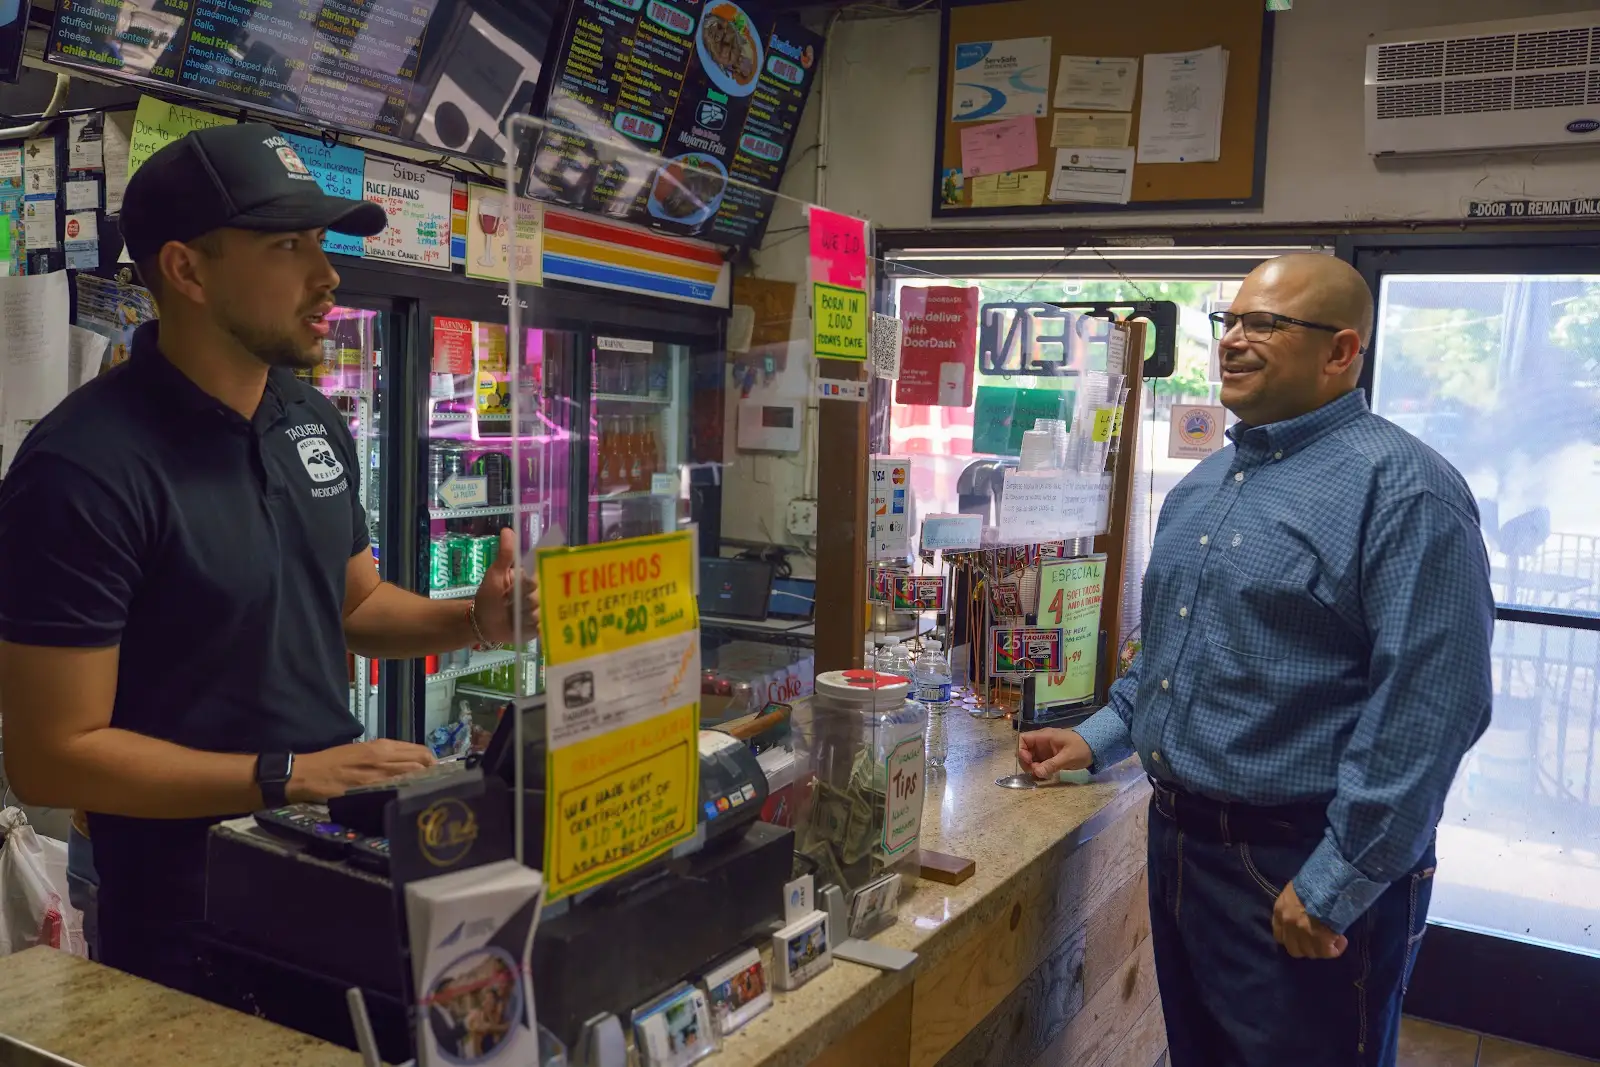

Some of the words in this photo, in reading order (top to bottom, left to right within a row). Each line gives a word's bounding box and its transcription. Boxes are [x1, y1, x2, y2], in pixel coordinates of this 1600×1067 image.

[63, 0, 70, 10] 2
[73, 2, 119, 23] Traditional
[196, 7, 240, 27] guacamole,
[228, 2, 252, 17] beans,
[321, 8, 350, 25] Shrimp
[351, 17, 369, 30] Taco
[61, 16, 92, 31] stuffed
[94, 24, 113, 36] with
[193, 18, 216, 32] Gallo.
[59, 28, 93, 45] cheese.
[191, 31, 214, 45] Mexi
[215, 38, 238, 50] Fries
[63, 45, 87, 58] chile
[89, 51, 125, 67] Relleno
[188, 44, 215, 60] French
[216, 53, 234, 64] Fries
[234, 57, 261, 72] topped
[984, 55, 1017, 66] ServSafe
[182, 70, 199, 81] and
[199, 75, 217, 88] your
[217, 79, 241, 92] choice
[185, 59, 214, 73] cheese,
[215, 66, 233, 78] sour
[234, 71, 258, 84] cream,
[169, 105, 224, 130] Attent
[135, 120, 153, 136] Due
[156, 124, 169, 141] to
[281, 134, 331, 158] tencion
[678, 131, 709, 151] Mojarra
[708, 138, 727, 156] Frita
[1477, 202, 1507, 217] DOOR
[1510, 202, 1524, 216] TO
[1527, 200, 1571, 215] REMAIN
[821, 234, 840, 252] WE
[820, 293, 844, 311] BORN
[848, 298, 859, 313] IN
[904, 310, 924, 322] We
[925, 312, 962, 323] deliver
[904, 324, 928, 336] with
[843, 339, 864, 354] DATE
[903, 336, 956, 349] DoorDash
[285, 423, 328, 442] TAQUERIA
[313, 466, 341, 480] MEXICO
[434, 540, 450, 590] Sprite
[470, 545, 485, 587] Sprite
[1051, 566, 1101, 583] ESPECIAL
[560, 552, 662, 599] TENEMOS
[901, 580, 915, 592] 26
[915, 579, 943, 588] TAQUERIA
[558, 600, 590, 621] GIFT
[1047, 588, 1064, 625] 4
[1081, 584, 1101, 597] TACOS
[1002, 634, 1021, 651] 25
[1022, 632, 1059, 643] TAQUERIA
[767, 677, 802, 704] Coke
[656, 780, 672, 797] OF
[892, 768, 917, 800] Tips
[564, 796, 588, 821] WE
[595, 782, 624, 806] HAVE
